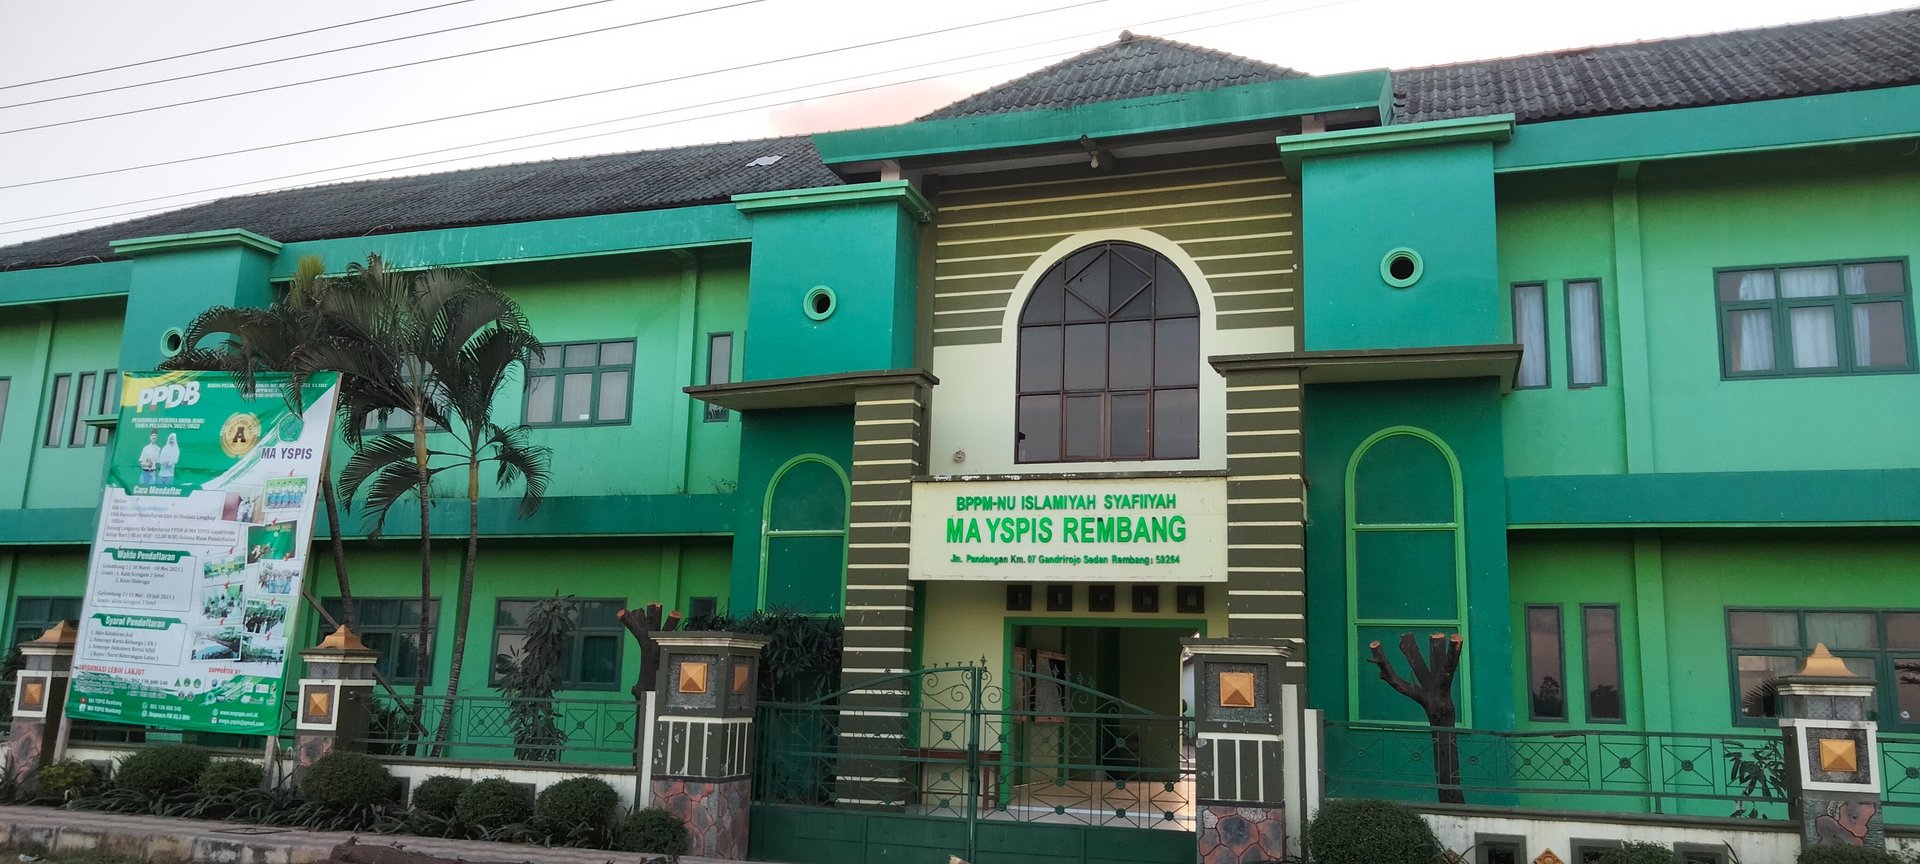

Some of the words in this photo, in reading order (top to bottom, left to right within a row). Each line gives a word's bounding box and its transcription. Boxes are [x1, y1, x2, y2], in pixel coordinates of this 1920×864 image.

[136, 381, 200, 413] PPDB
[233, 426, 246, 443] A
[261, 448, 276, 459] MA
[281, 448, 312, 460] YSPIS
[134, 486, 149, 494] Cara
[150, 486, 182, 495] Mendaftar
[956, 496, 1016, 512] BPPM-NU
[1021, 495, 1096, 510] ISLAMIYAH
[1104, 494, 1176, 509] SYAFIIYAH
[946, 518, 982, 544] MA
[986, 517, 1053, 544] YSPIS
[1063, 515, 1186, 544] REMBANG
[118, 550, 136, 559] Waktu
[137, 551, 176, 561] Pendaftaran
[950, 554, 963, 564] Jln.
[966, 554, 1008, 566] Pandangan
[1010, 555, 1026, 564] Km.
[1038, 555, 1082, 566] Gandrirojo
[1084, 555, 1108, 564] Sedan
[106, 616, 126, 626] Syarat
[126, 617, 165, 628] Pendaftaran
